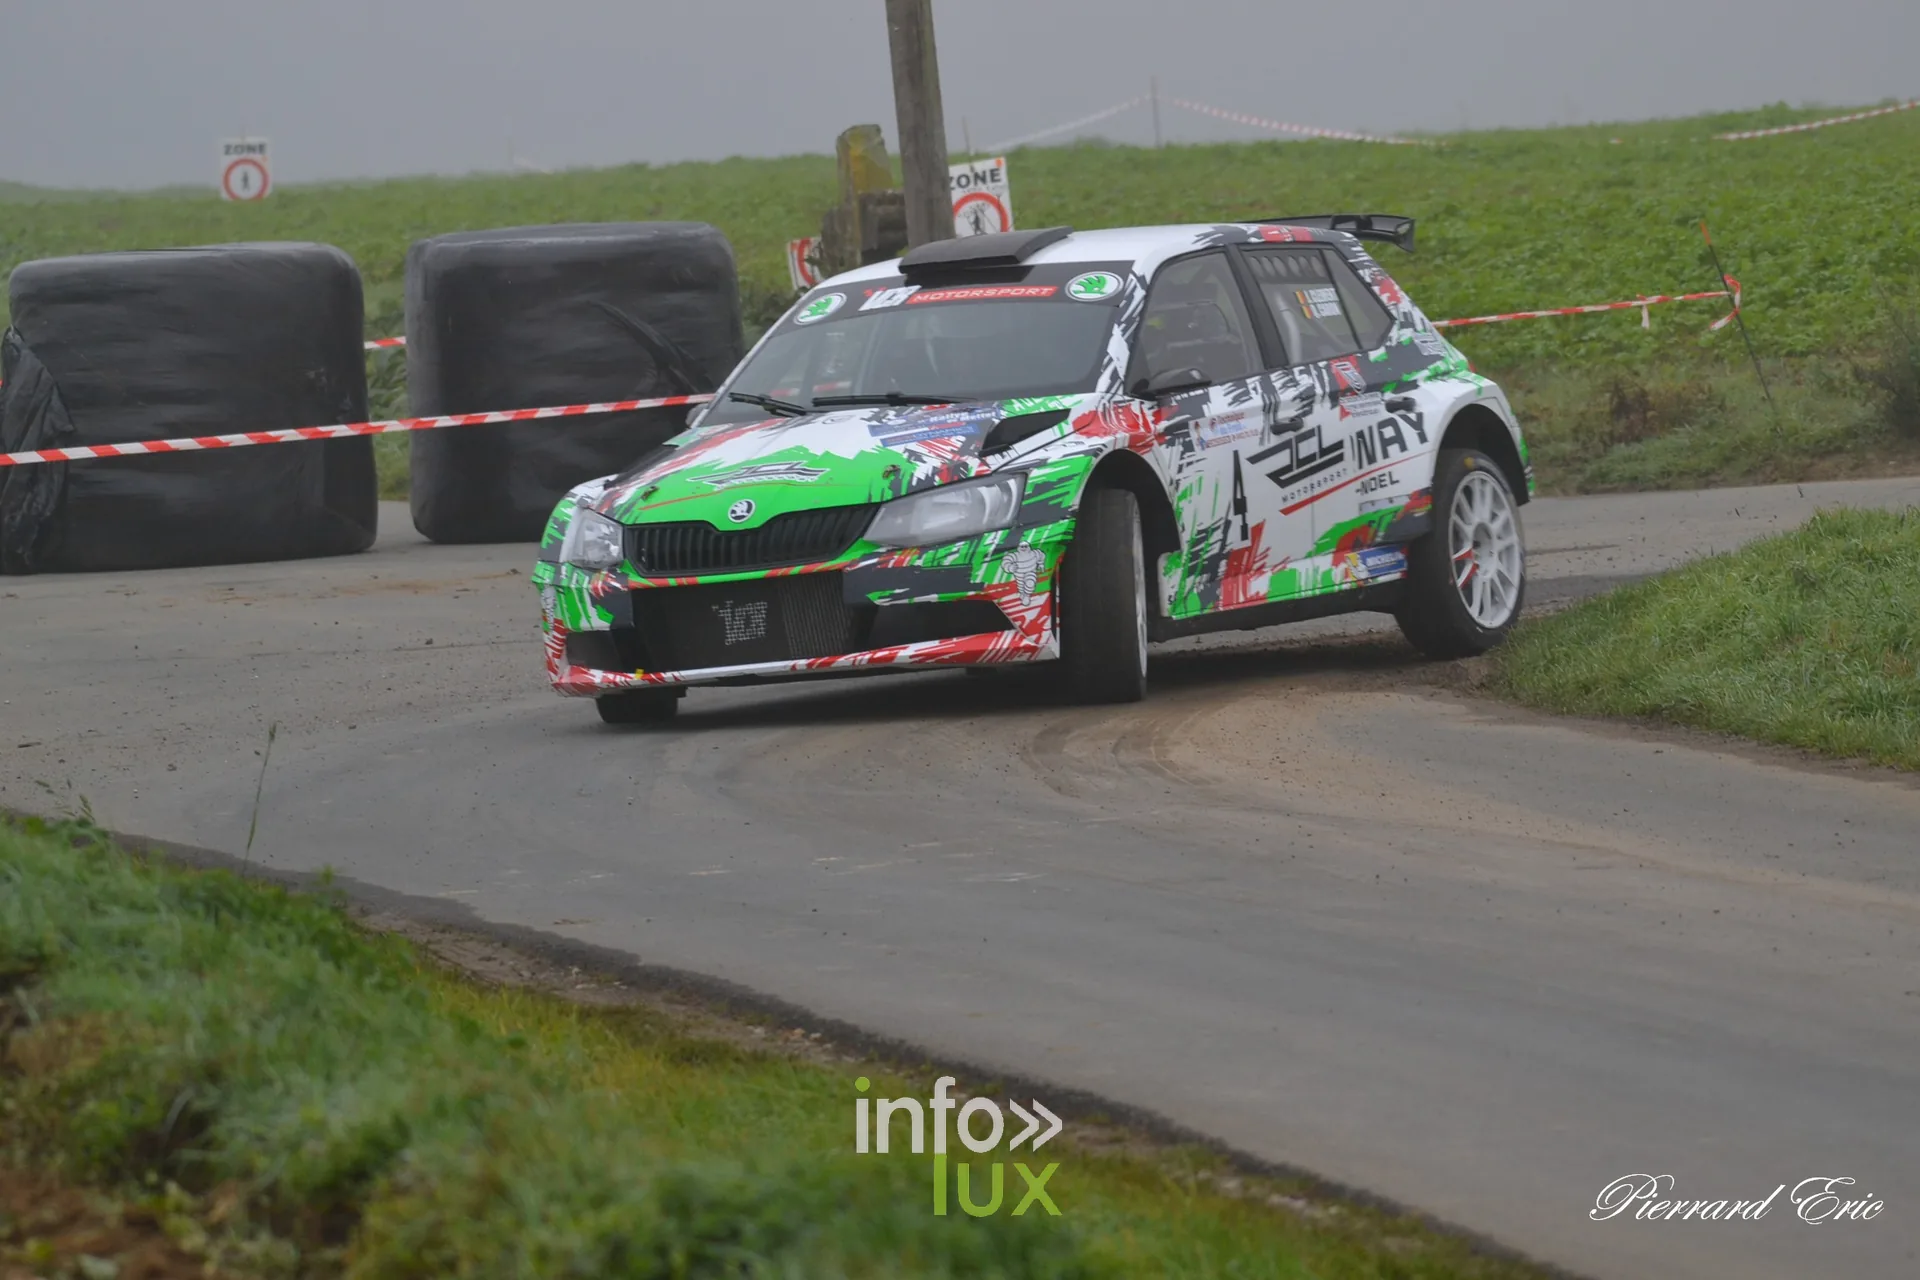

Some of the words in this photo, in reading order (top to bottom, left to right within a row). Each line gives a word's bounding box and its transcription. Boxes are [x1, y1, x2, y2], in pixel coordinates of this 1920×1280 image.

[223, 143, 267, 156] ZONE
[912, 287, 1053, 302] MOTORSPORT
[1281, 468, 1348, 504] MOTORSPORT
